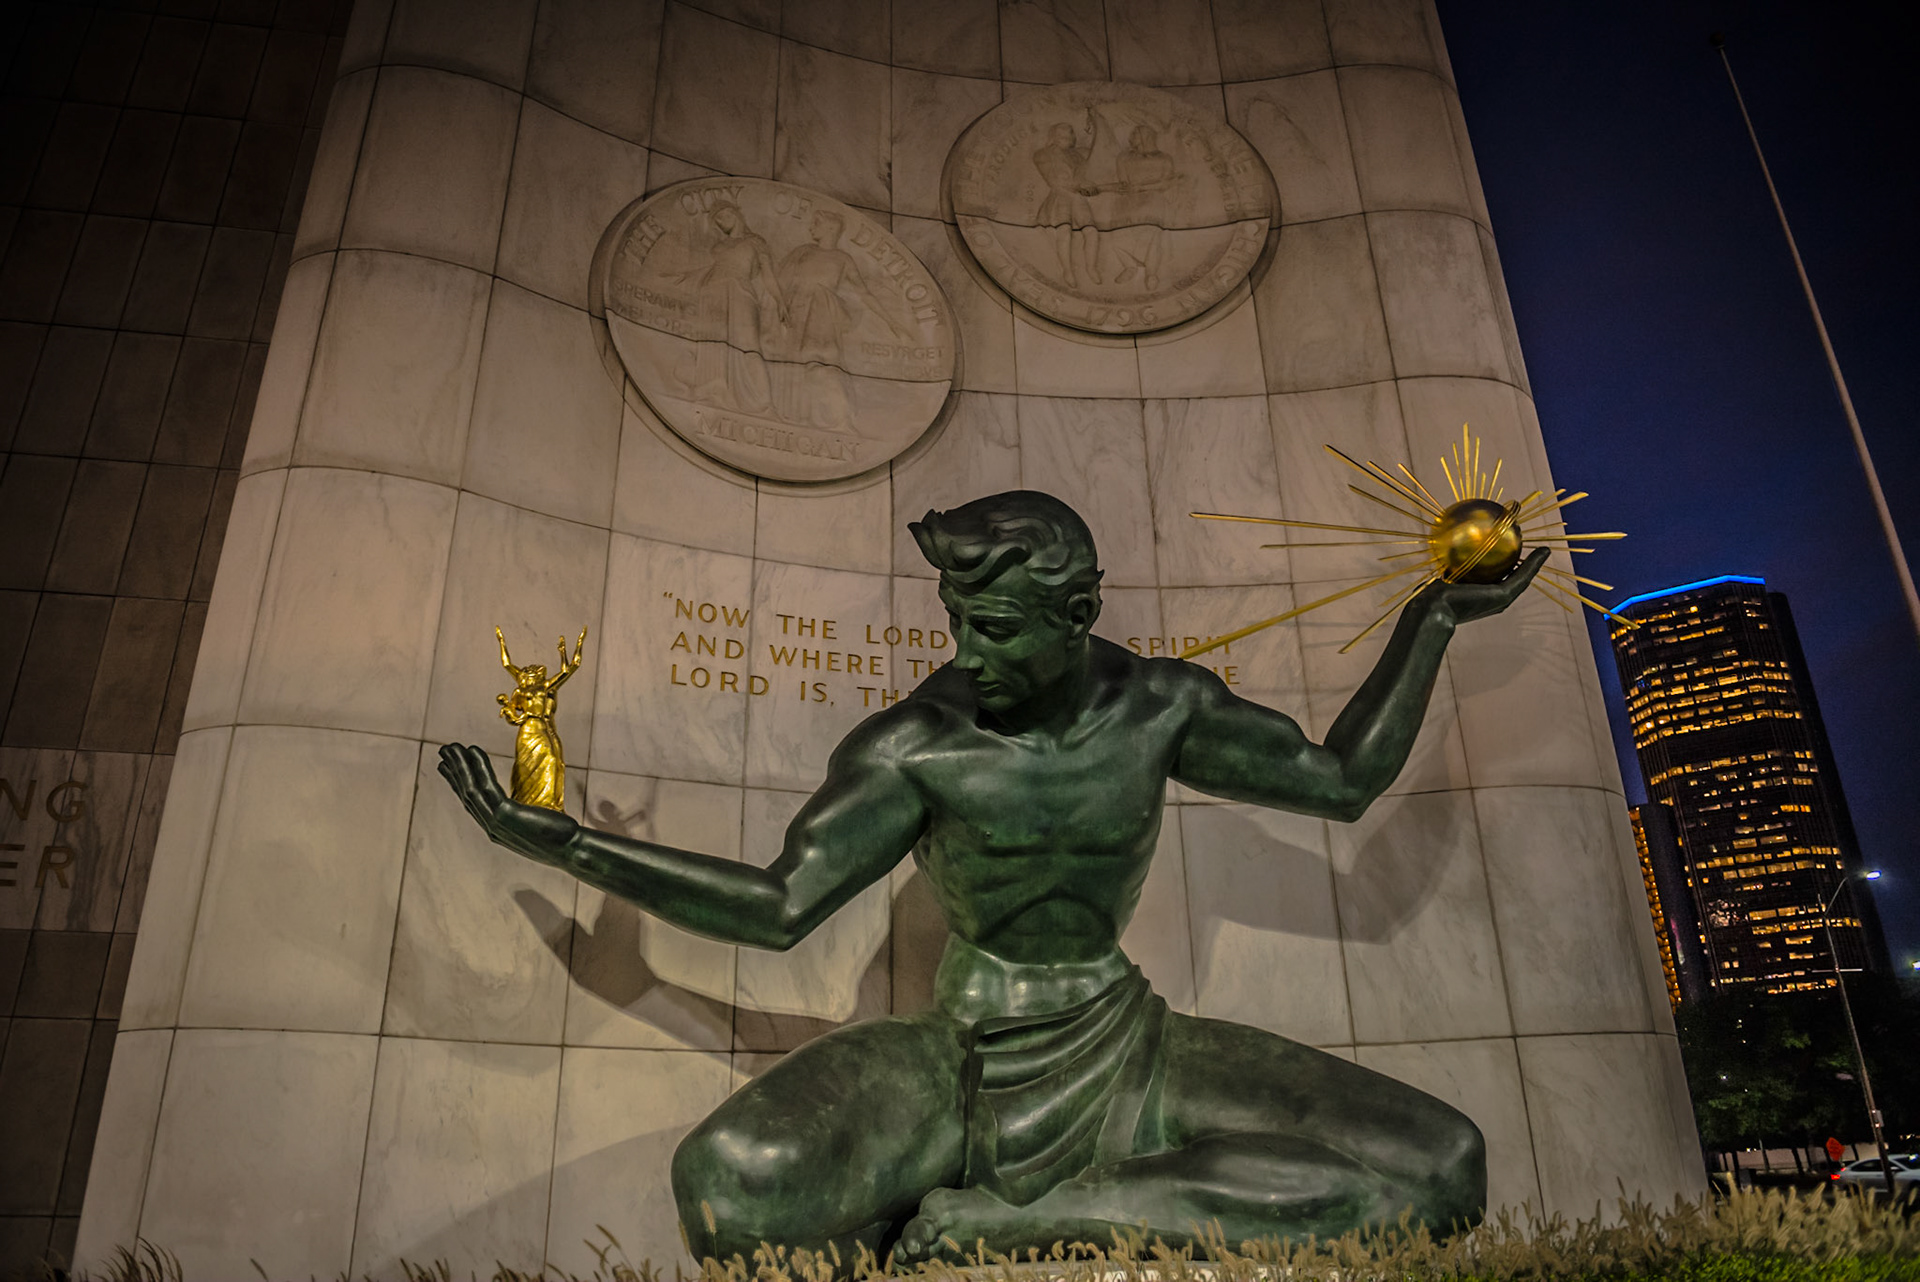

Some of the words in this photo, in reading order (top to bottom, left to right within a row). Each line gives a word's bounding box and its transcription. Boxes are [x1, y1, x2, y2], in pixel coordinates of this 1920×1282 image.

[679, 184, 746, 217] CITY
[774, 190, 814, 221] OF
[850, 222, 945, 328] DETROIT
[1086, 305, 1159, 328] 1796
[695, 410, 861, 463] MICHIGAN
[776, 613, 839, 641] THE
[865, 624, 949, 650] LORD
[670, 631, 745, 660] AND
[769, 645, 885, 676] WHERE
[671, 664, 770, 696] LORD
[800, 681, 835, 706] IS,
